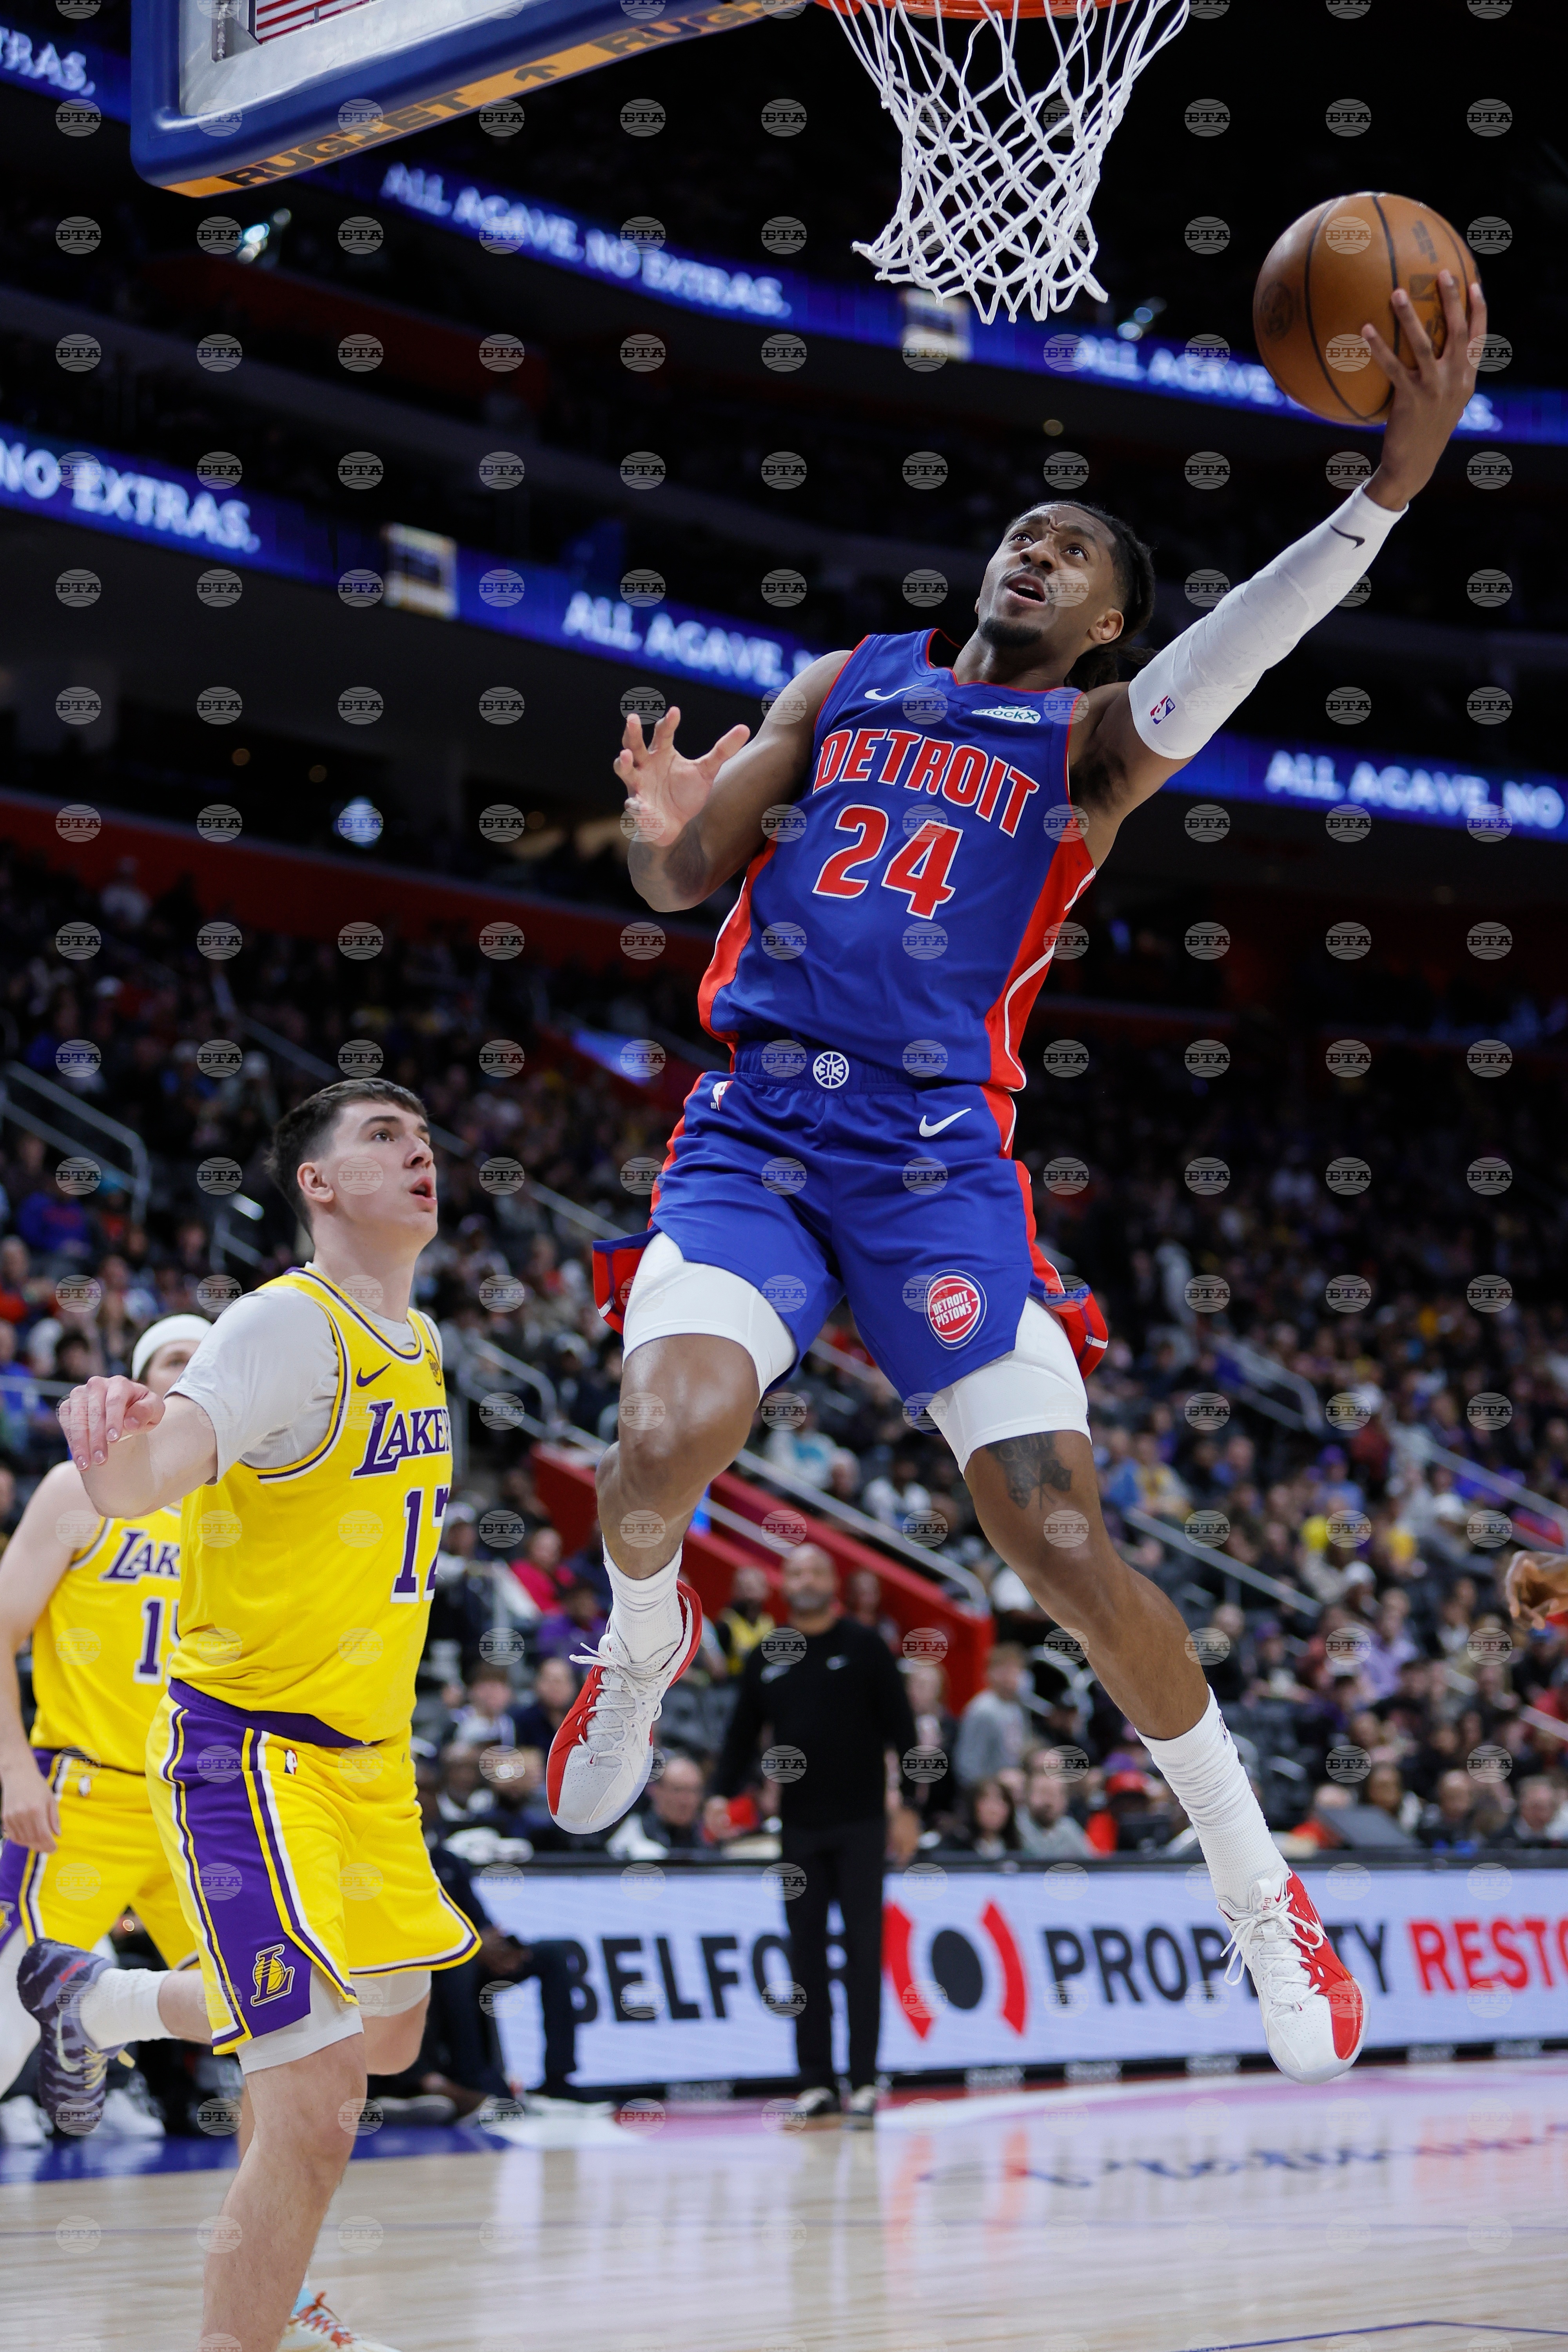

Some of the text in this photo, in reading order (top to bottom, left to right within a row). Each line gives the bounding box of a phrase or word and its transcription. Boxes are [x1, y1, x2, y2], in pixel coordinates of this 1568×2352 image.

[380, 162, 451, 216] ALL
[71, 461, 260, 554] EXTRAS.
[562, 591, 642, 651] ALL
[812, 728, 1040, 838] DETROIT
[1265, 750, 1346, 800] ALL
[1503, 780, 1566, 829] NO
[812, 804, 963, 920] 24
[816, 1058, 846, 1082] 313
[931, 1290, 968, 1316] DETROIT
[935, 1301, 972, 1328] PISTONS
[1408, 1918, 1568, 1992] REST
